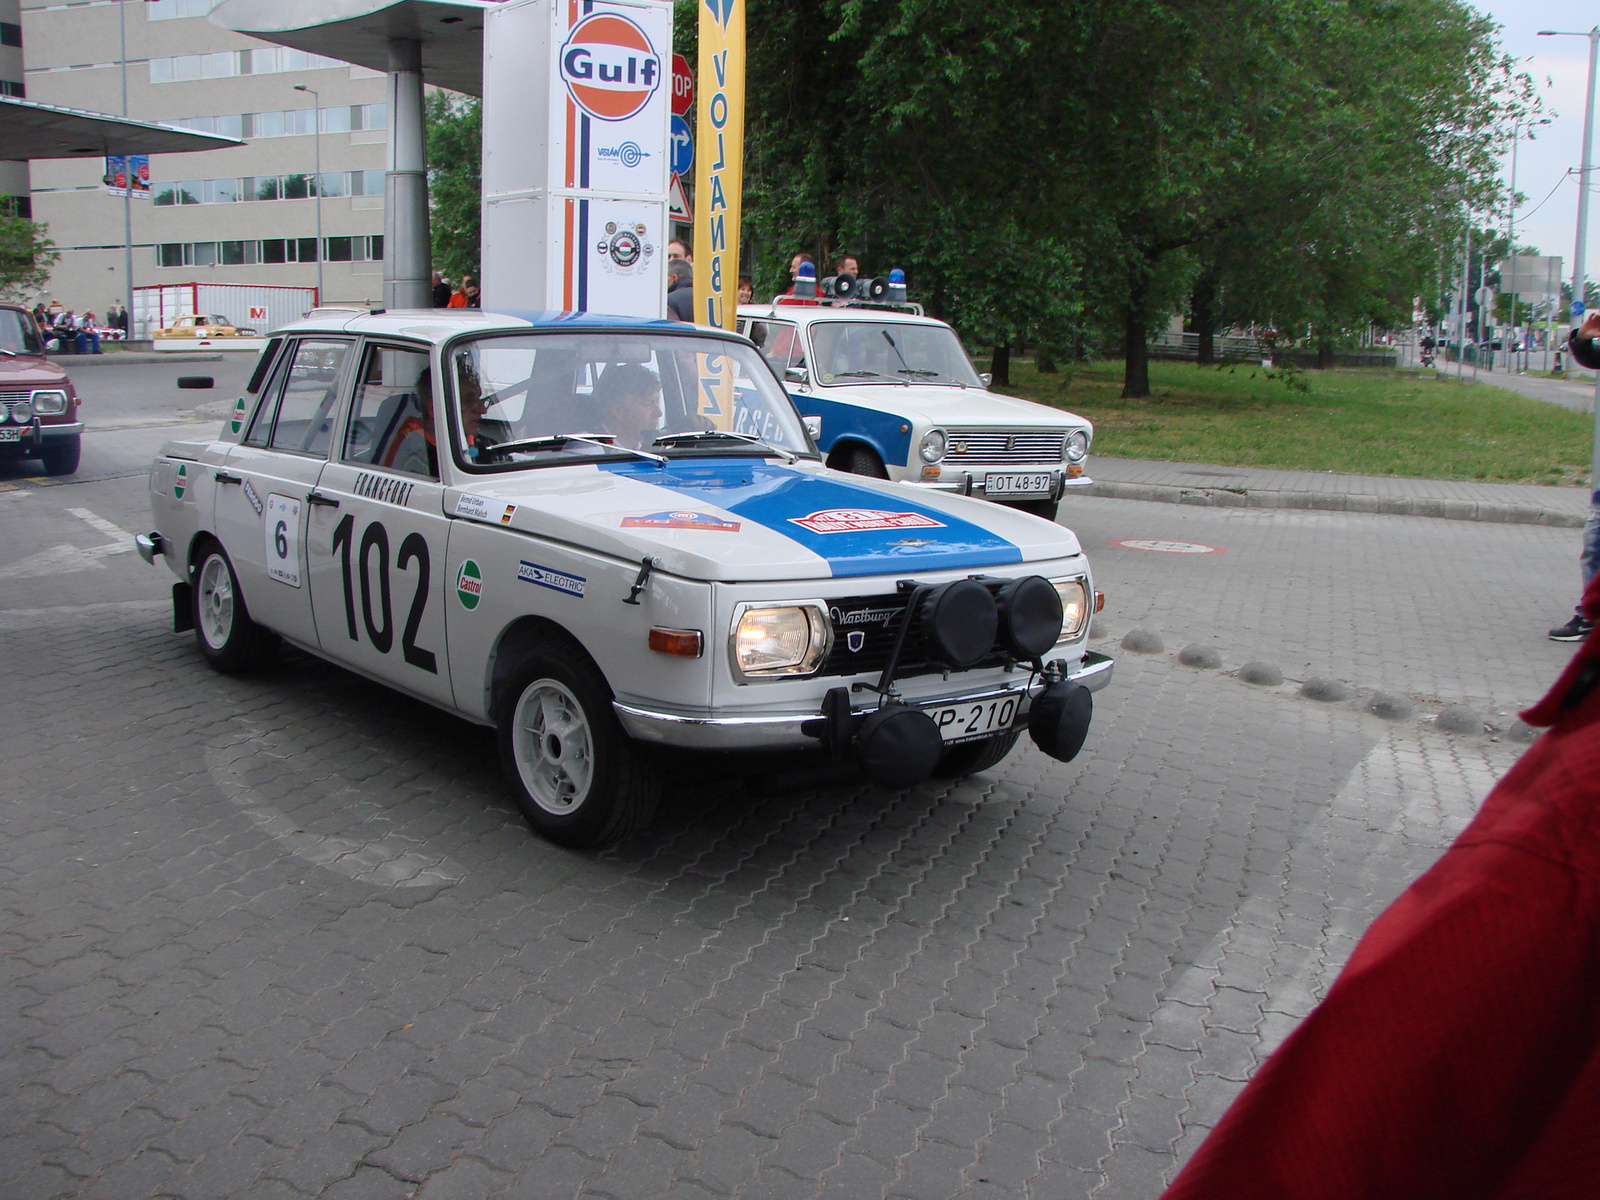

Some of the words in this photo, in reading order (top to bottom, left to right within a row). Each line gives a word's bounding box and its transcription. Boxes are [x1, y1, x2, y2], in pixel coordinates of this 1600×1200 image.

[564, 48, 657, 86] Gulf
[672, 73, 692, 98] OP
[275, 519, 288, 560] 6
[331, 513, 438, 675] 102
[460, 576, 483, 594] Castrol
[518, 565, 534, 578] AKA
[544, 572, 584, 592] ELECTRIC
[830, 606, 906, 628] Wartburg
[931, 699, 1014, 734] P-210
